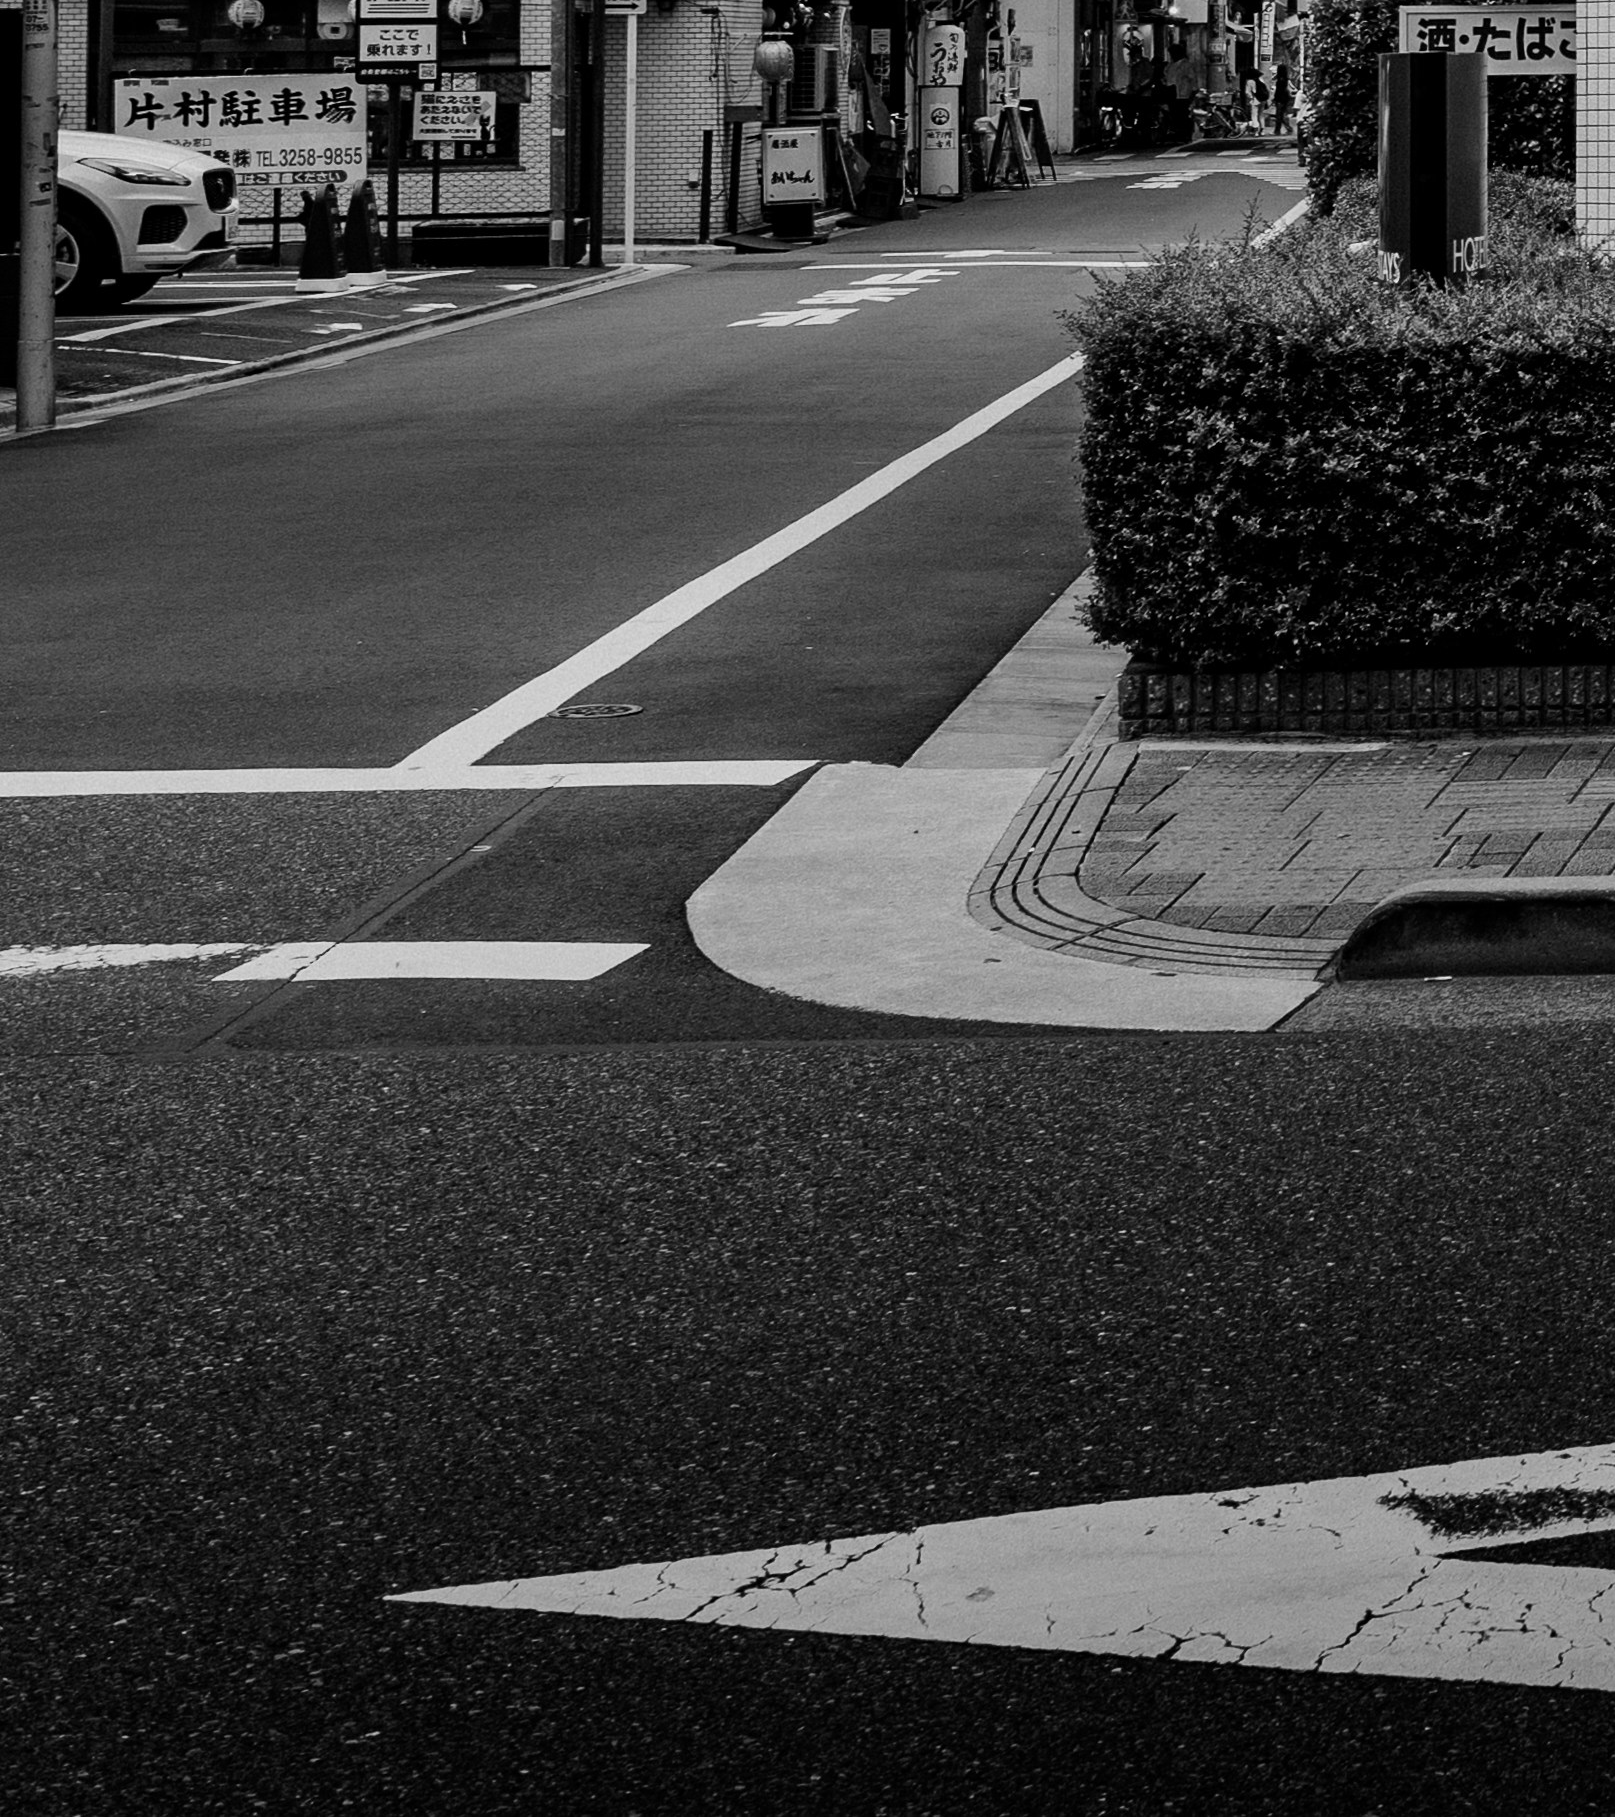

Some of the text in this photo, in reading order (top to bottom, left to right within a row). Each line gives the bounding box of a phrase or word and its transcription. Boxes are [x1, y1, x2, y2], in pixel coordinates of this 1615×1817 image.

[379, 29, 420, 41] ここで
[123, 87, 357, 130] 片村駐車場
[279, 147, 363, 167] 3258-9855
